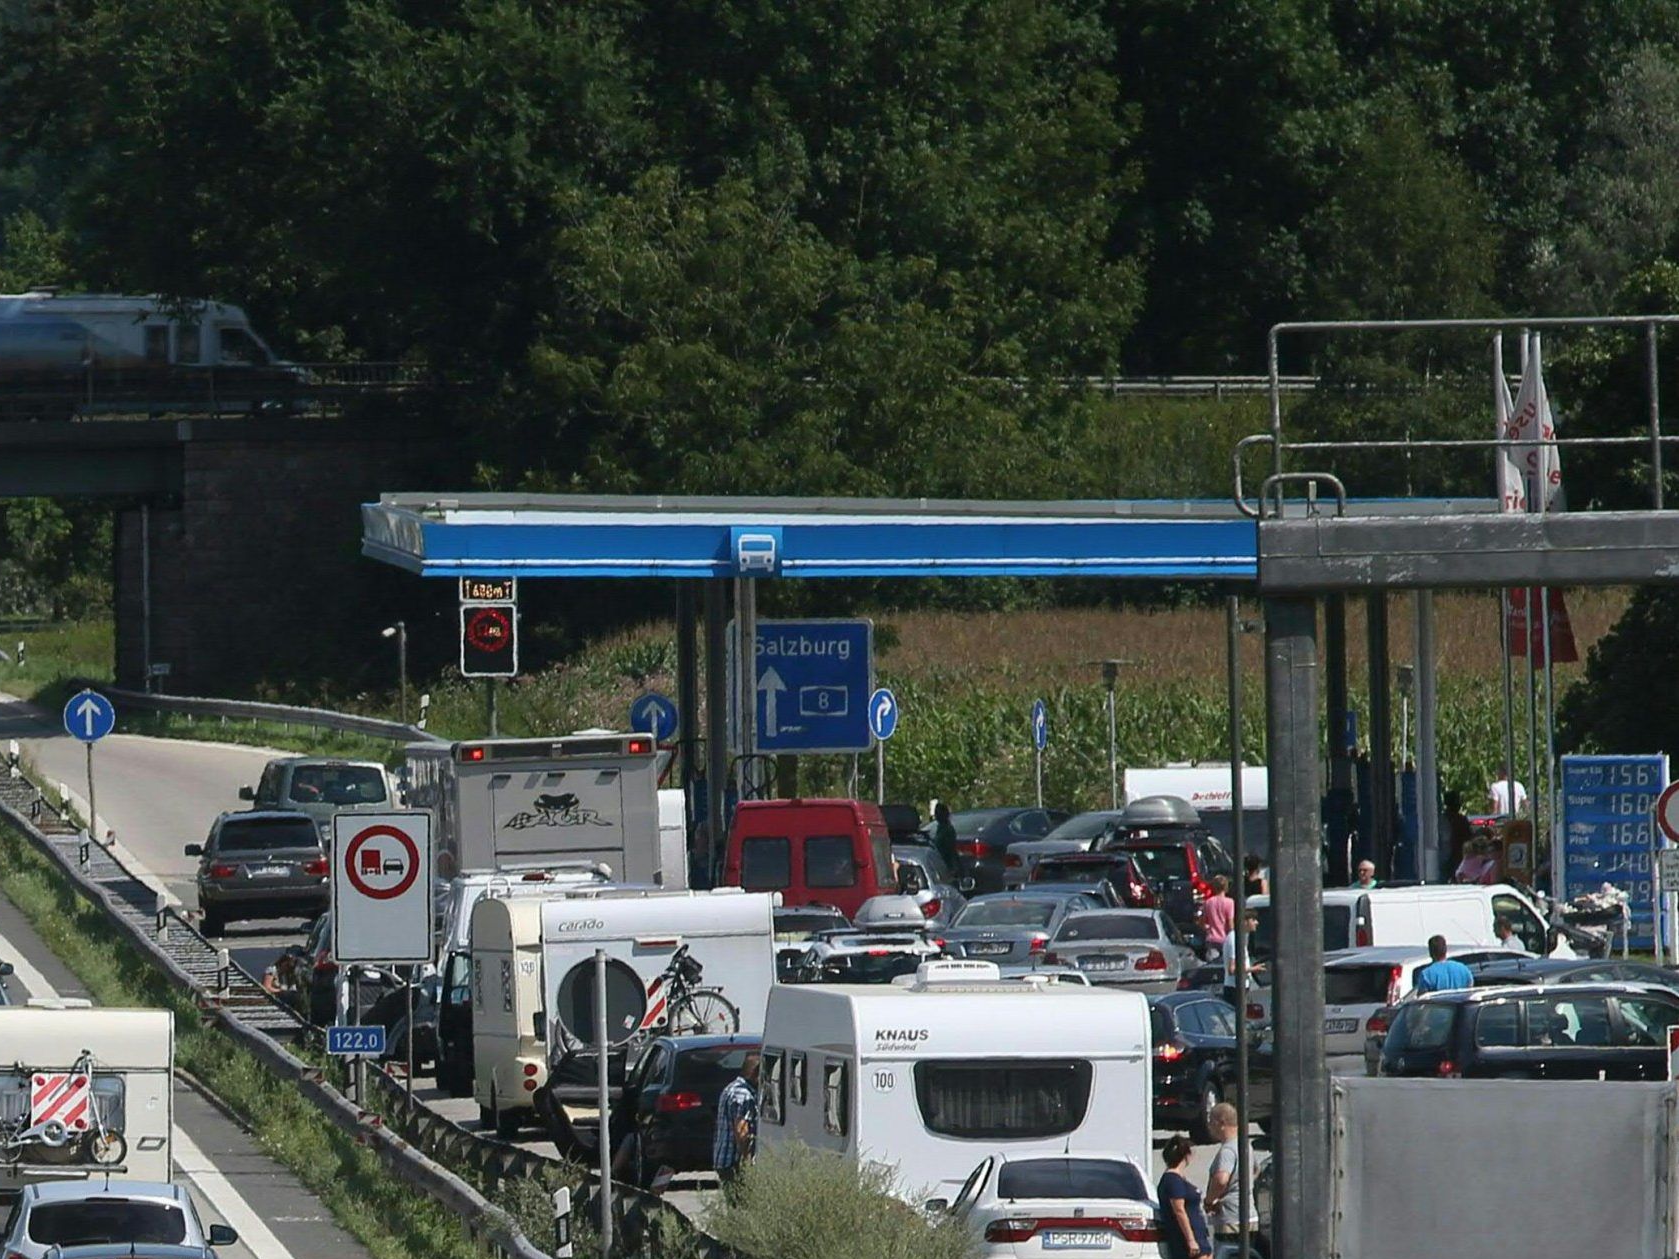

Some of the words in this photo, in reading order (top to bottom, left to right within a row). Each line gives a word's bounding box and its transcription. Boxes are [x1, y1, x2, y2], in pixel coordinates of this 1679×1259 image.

[755, 636, 850, 660] Salzburg
[818, 692, 830, 709] 8
[1568, 795, 1596, 806] Super
[335, 1032, 378, 1049] 122,0
[874, 1029, 929, 1041] KNAUS
[874, 1042, 917, 1052] Südwind
[875, 1072, 895, 1088] 100
